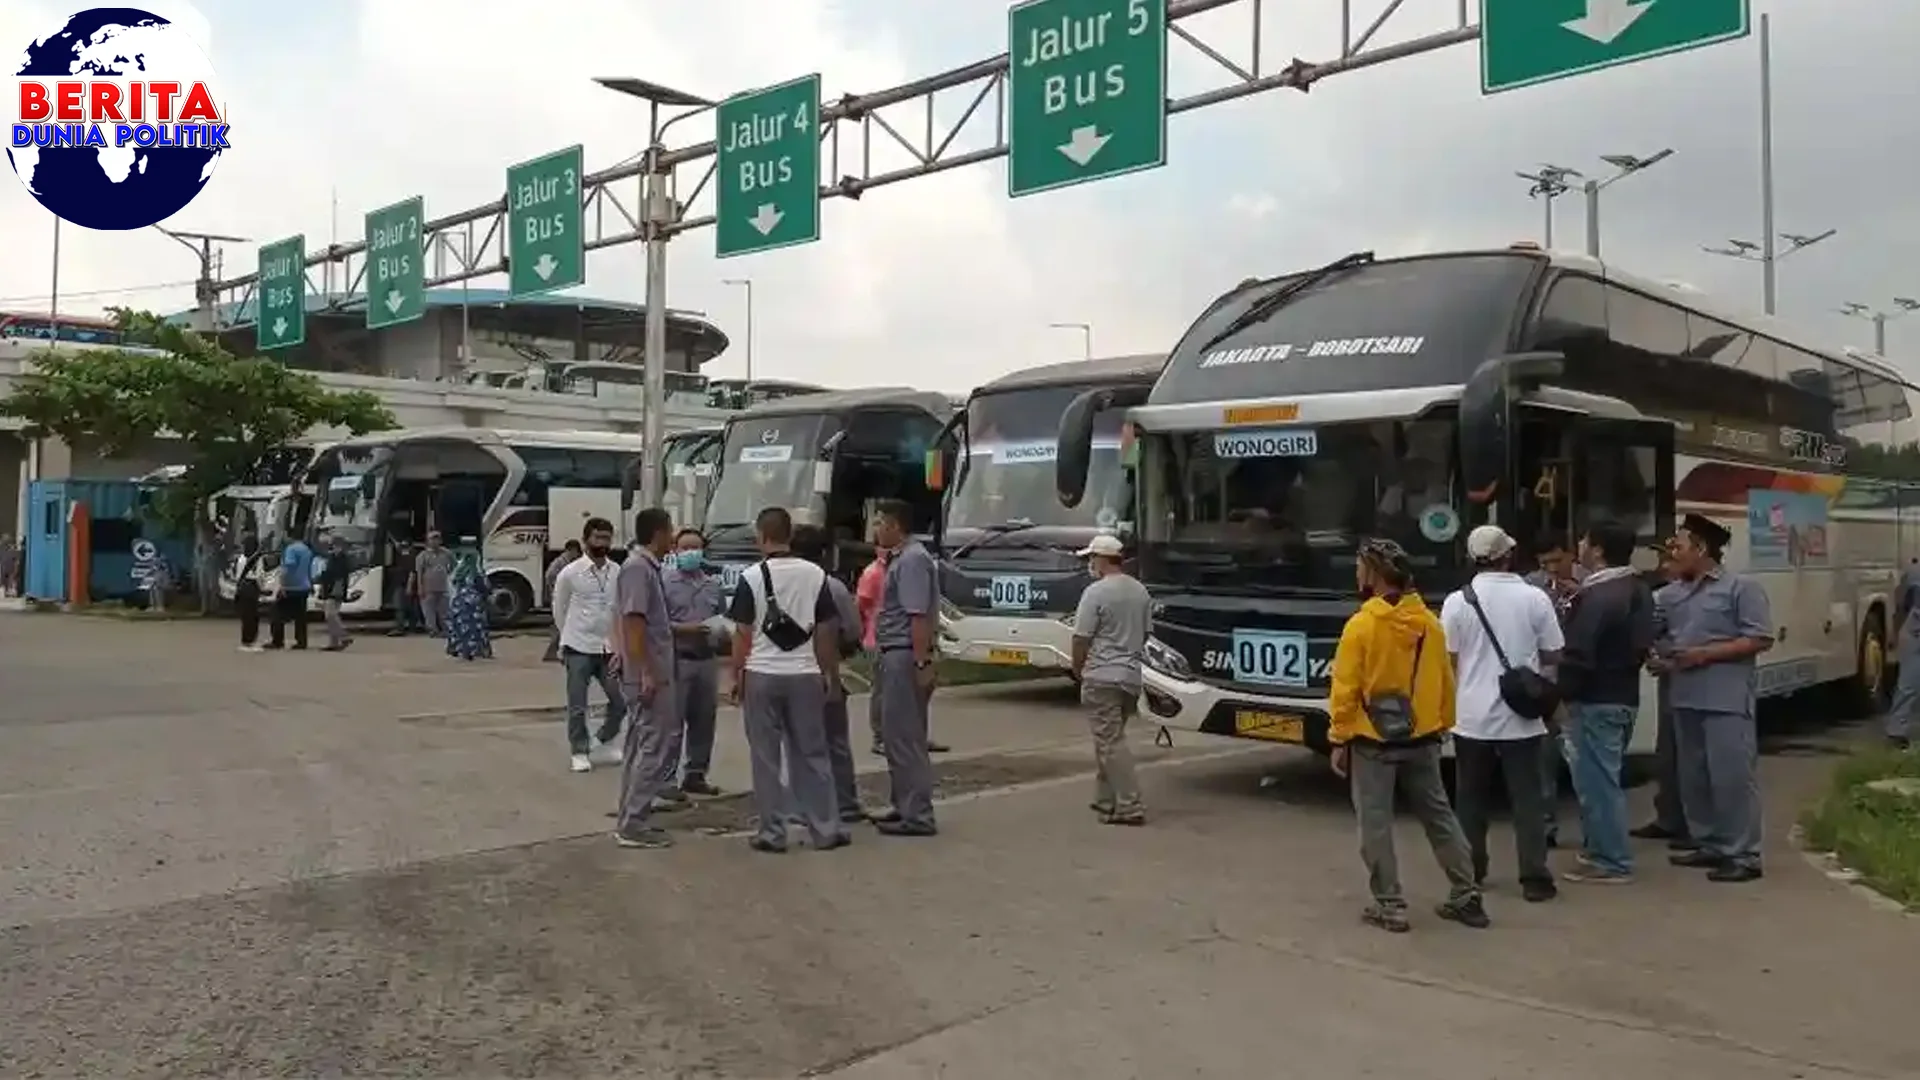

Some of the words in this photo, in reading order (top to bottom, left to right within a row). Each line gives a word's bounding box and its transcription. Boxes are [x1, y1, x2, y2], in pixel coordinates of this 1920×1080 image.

[1021, 11, 1113, 67] Jalur
[1128, 0, 1149, 36] 5
[1044, 64, 1125, 115] Bus
[724, 113, 788, 153] Jalur
[793, 101, 812, 134] 4
[513, 176, 560, 211] Jalur
[563, 168, 576, 196] 3
[739, 155, 792, 192] Bus
[370, 221, 404, 251] Jalur
[408, 216, 417, 240] 2
[525, 213, 564, 243] Bus
[378, 254, 410, 281] Bus
[267, 286, 294, 309] Bus
[1219, 435, 1314, 455] WONOGIRI
[994, 582, 1027, 603] 008
[1202, 650, 1236, 673] SIN
[1239, 640, 1301, 678] 002
